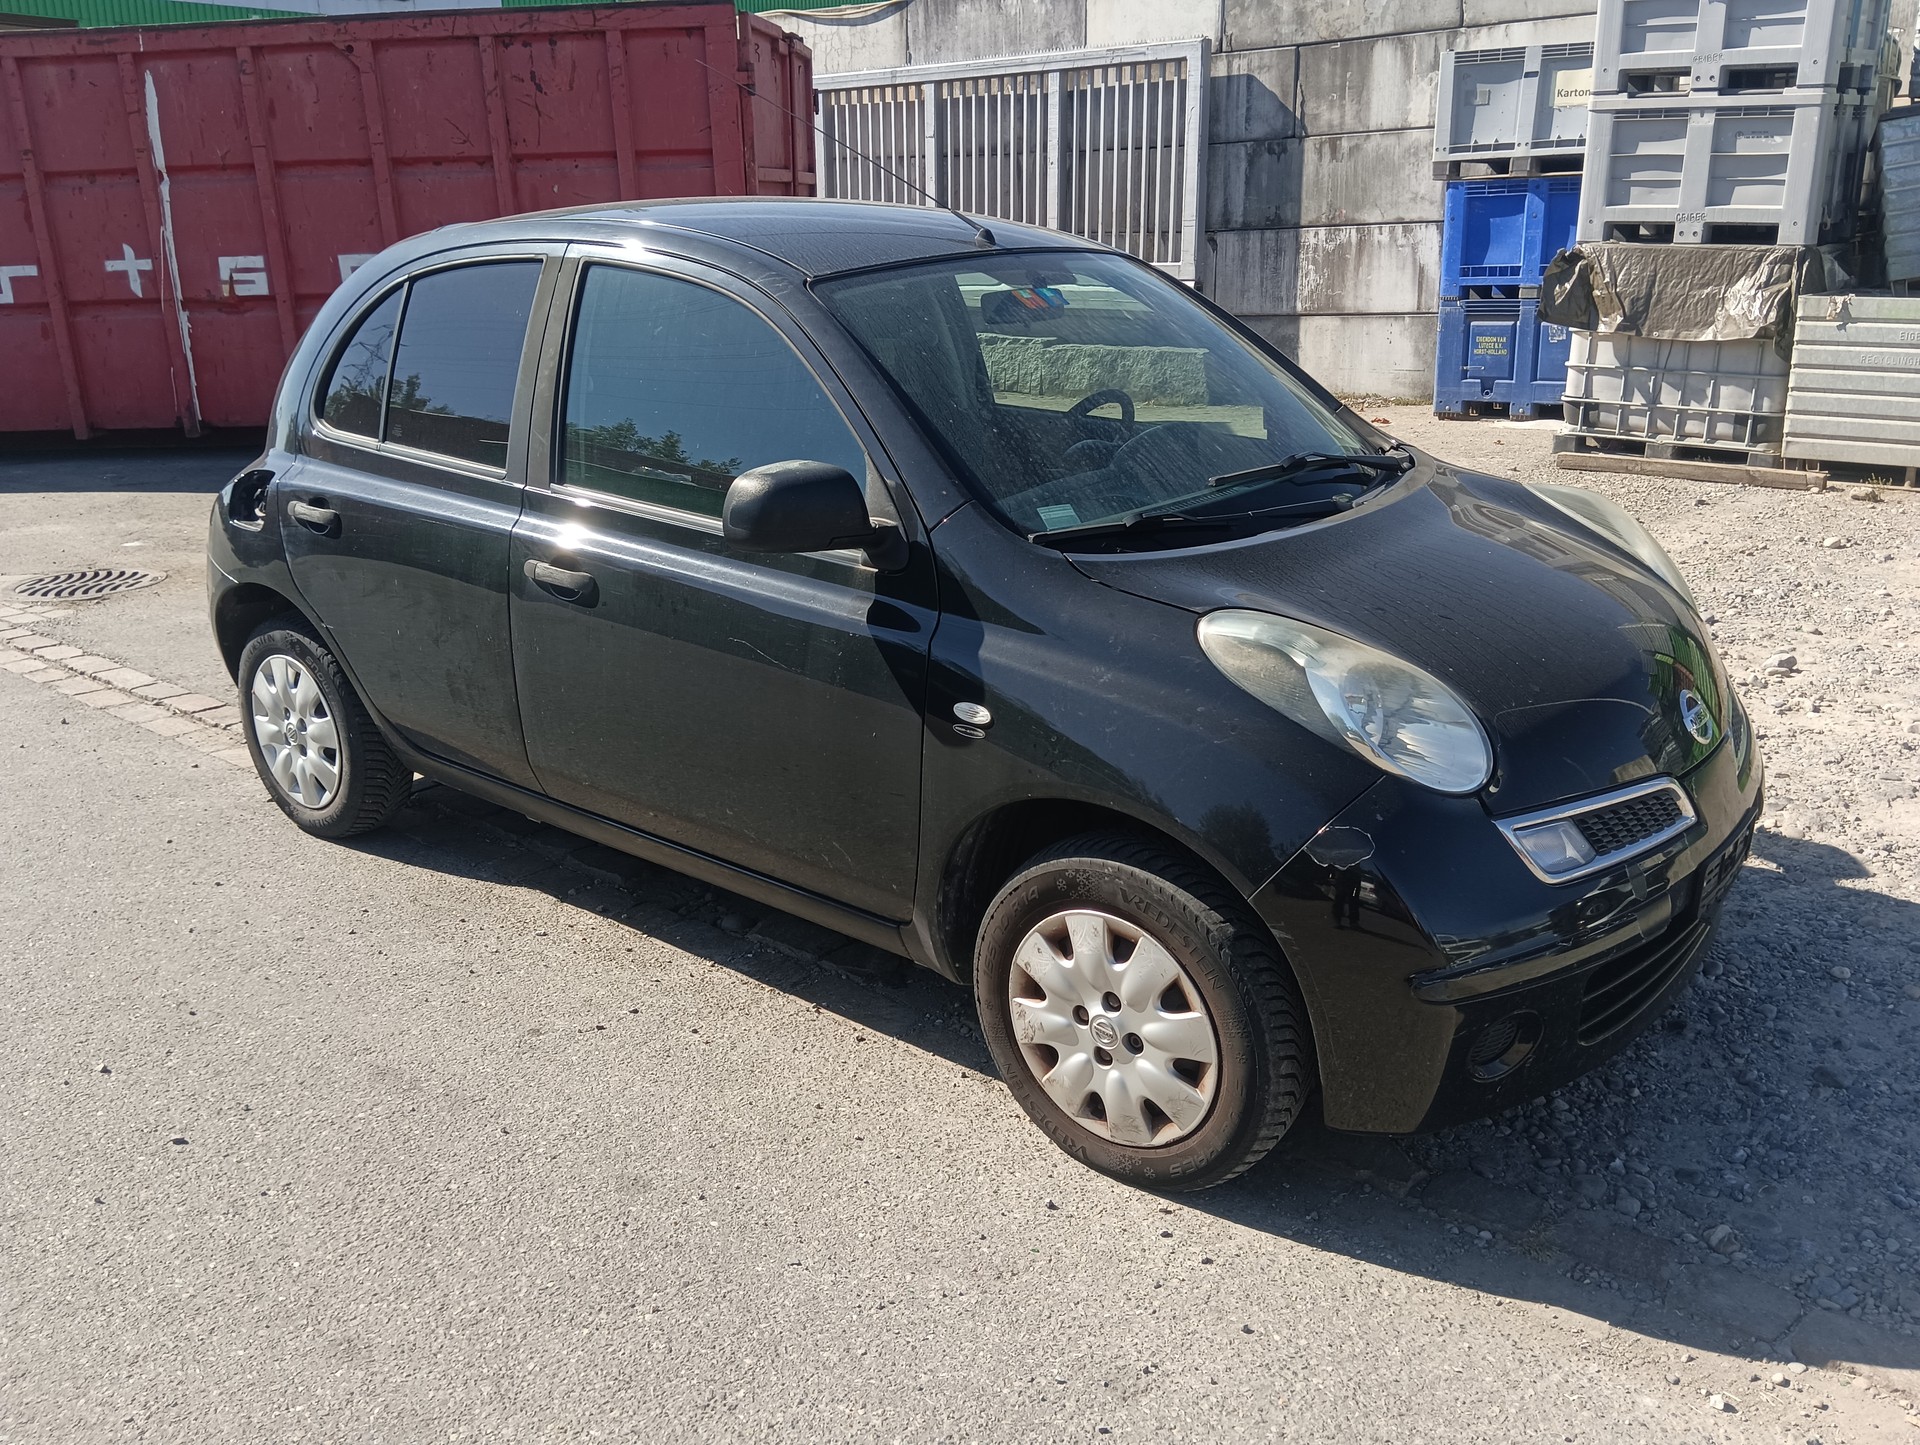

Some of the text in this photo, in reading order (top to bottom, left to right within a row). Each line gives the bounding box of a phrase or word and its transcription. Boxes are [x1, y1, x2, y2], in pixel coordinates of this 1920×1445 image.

[1556, 88, 1591, 98] Karton
[1120, 887, 1225, 990] VREDESTEIN
[1003, 1063, 1090, 1161] VREDESTEIN
